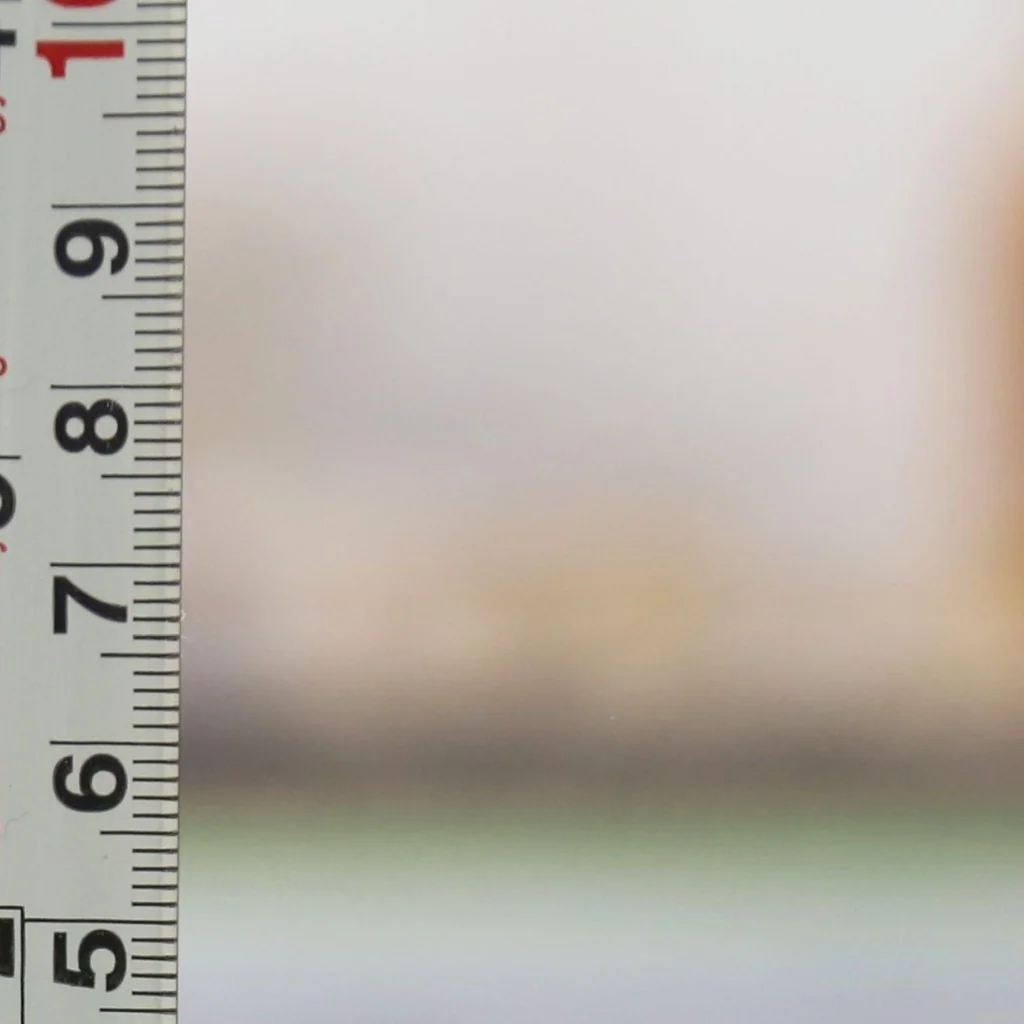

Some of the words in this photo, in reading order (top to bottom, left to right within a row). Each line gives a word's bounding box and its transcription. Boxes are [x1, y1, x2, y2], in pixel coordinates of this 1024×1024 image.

[36, 0, 124, 79] 1
[54, 218, 129, 278] 9
[54, 399, 129, 455] 8
[53, 576, 128, 634] 7
[53, 753, 128, 812] 6
[53, 929, 127, 992] 5
